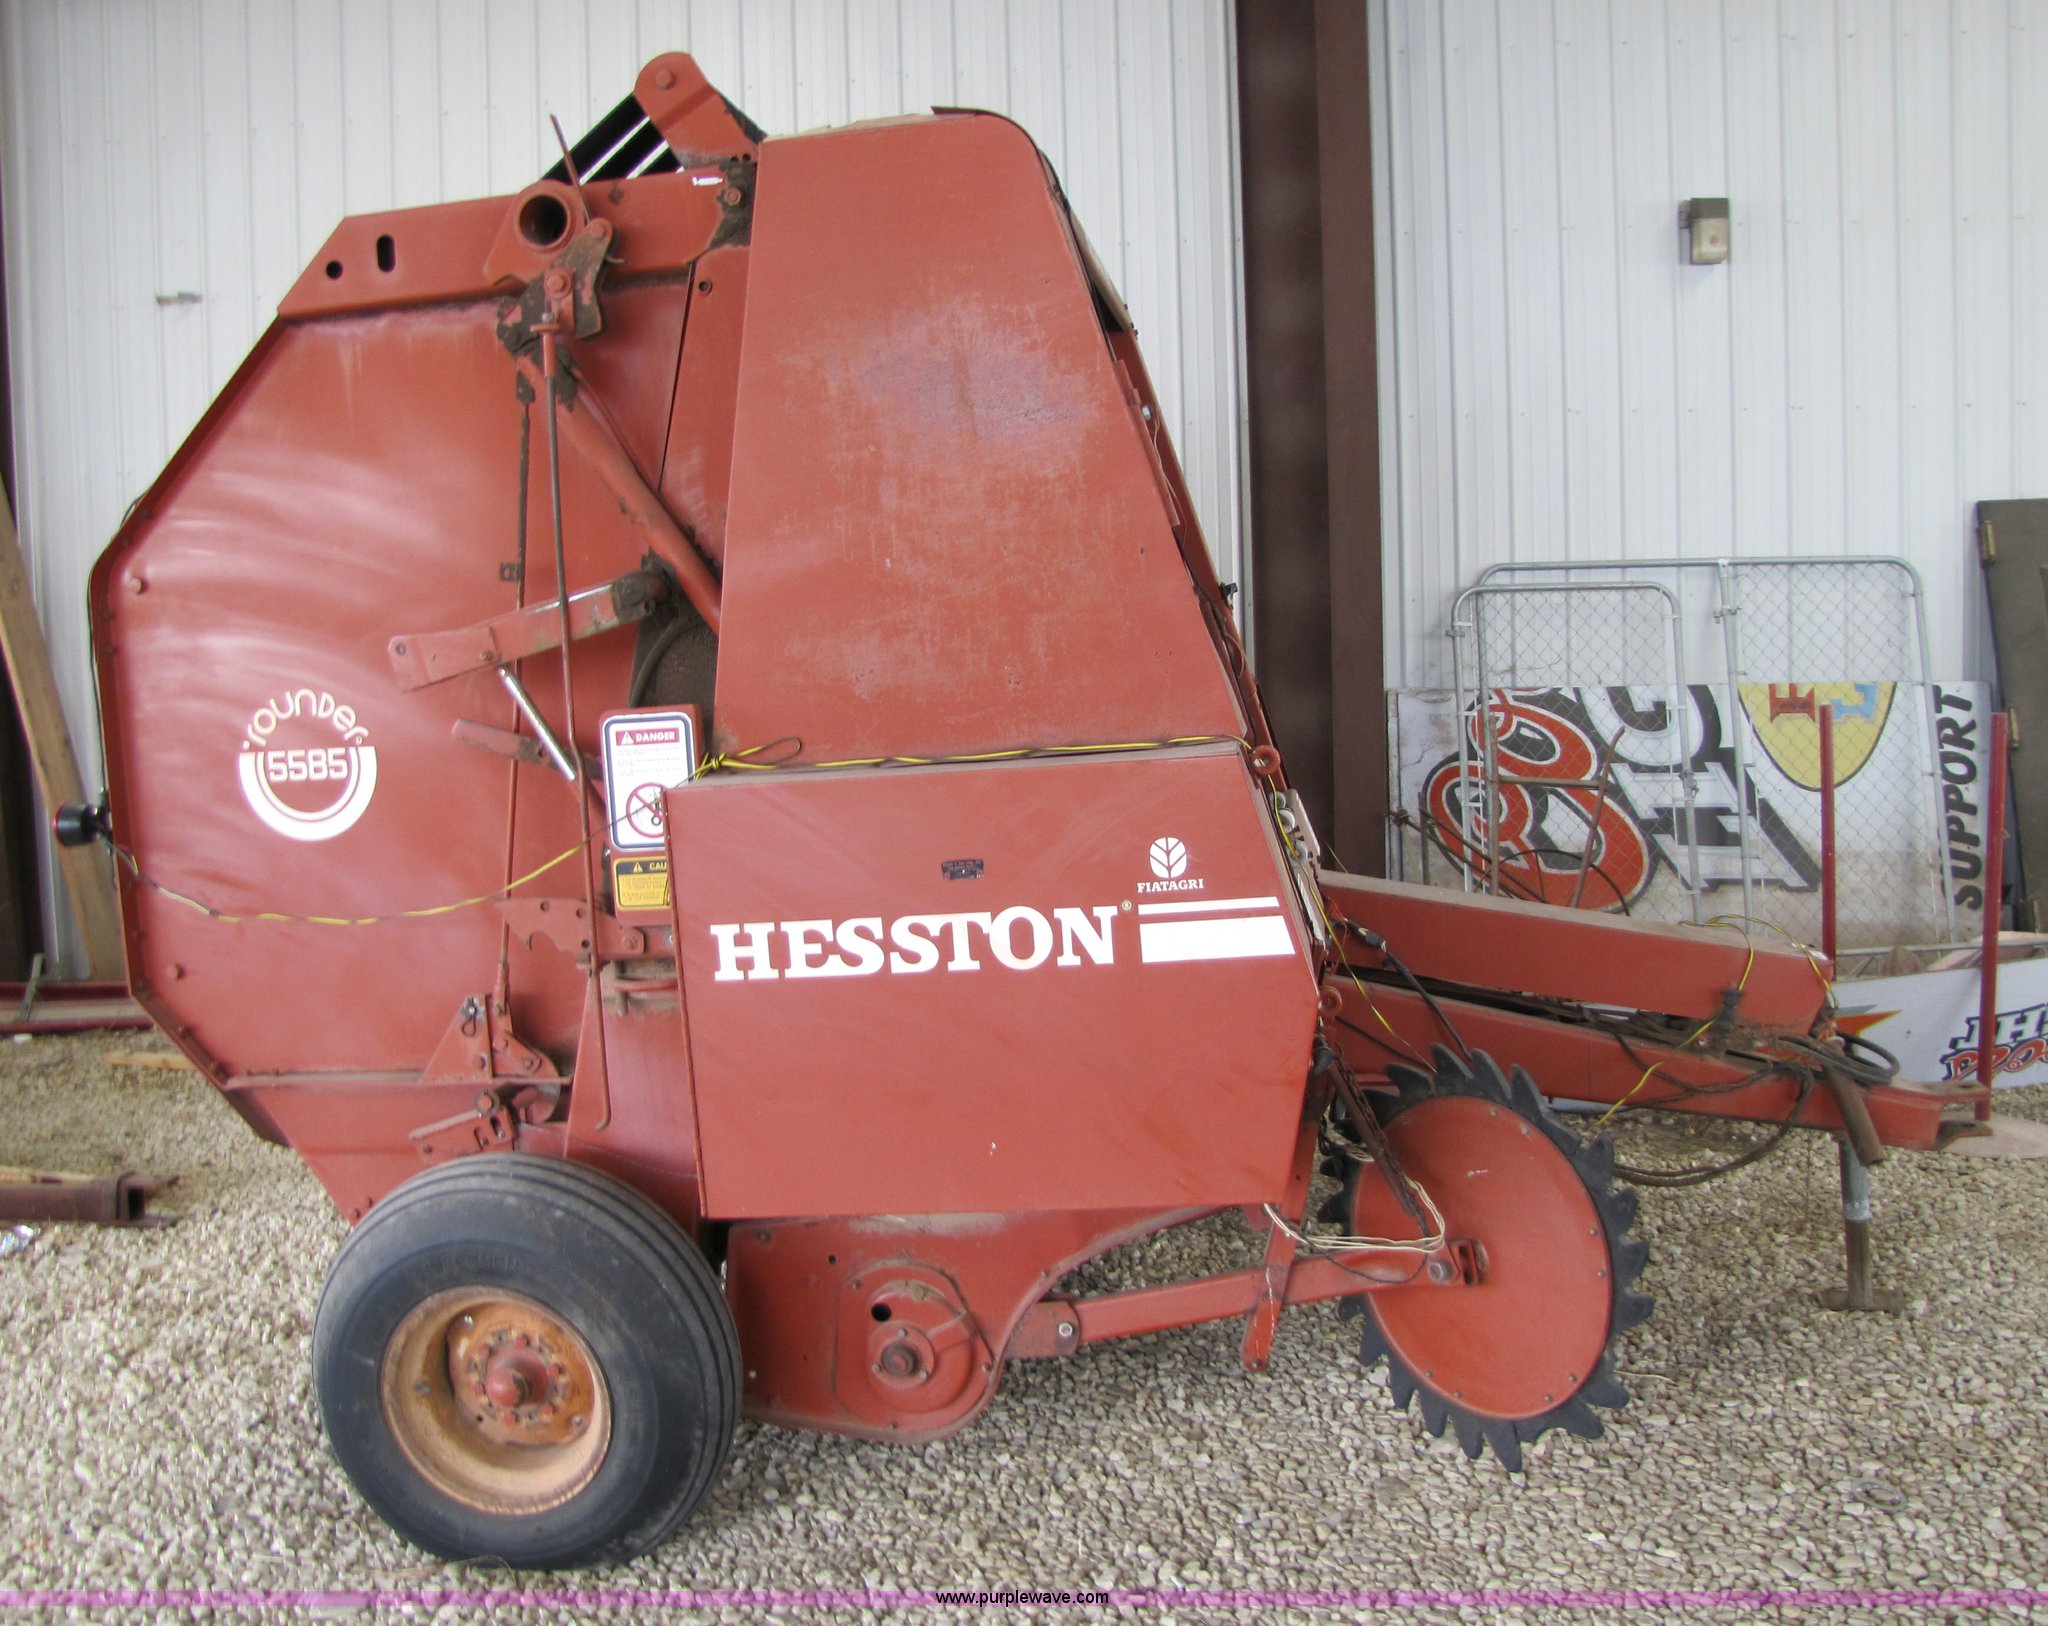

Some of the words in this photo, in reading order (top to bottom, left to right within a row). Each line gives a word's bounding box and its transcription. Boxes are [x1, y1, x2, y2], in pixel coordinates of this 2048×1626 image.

[635, 730, 676, 743] DANGER
[268, 747, 349, 783] 5585
[1933, 684, 1983, 910] SUPPORT
[1136, 878, 1205, 893] FIATAGRI
[709, 905, 1119, 982] HESSTON
